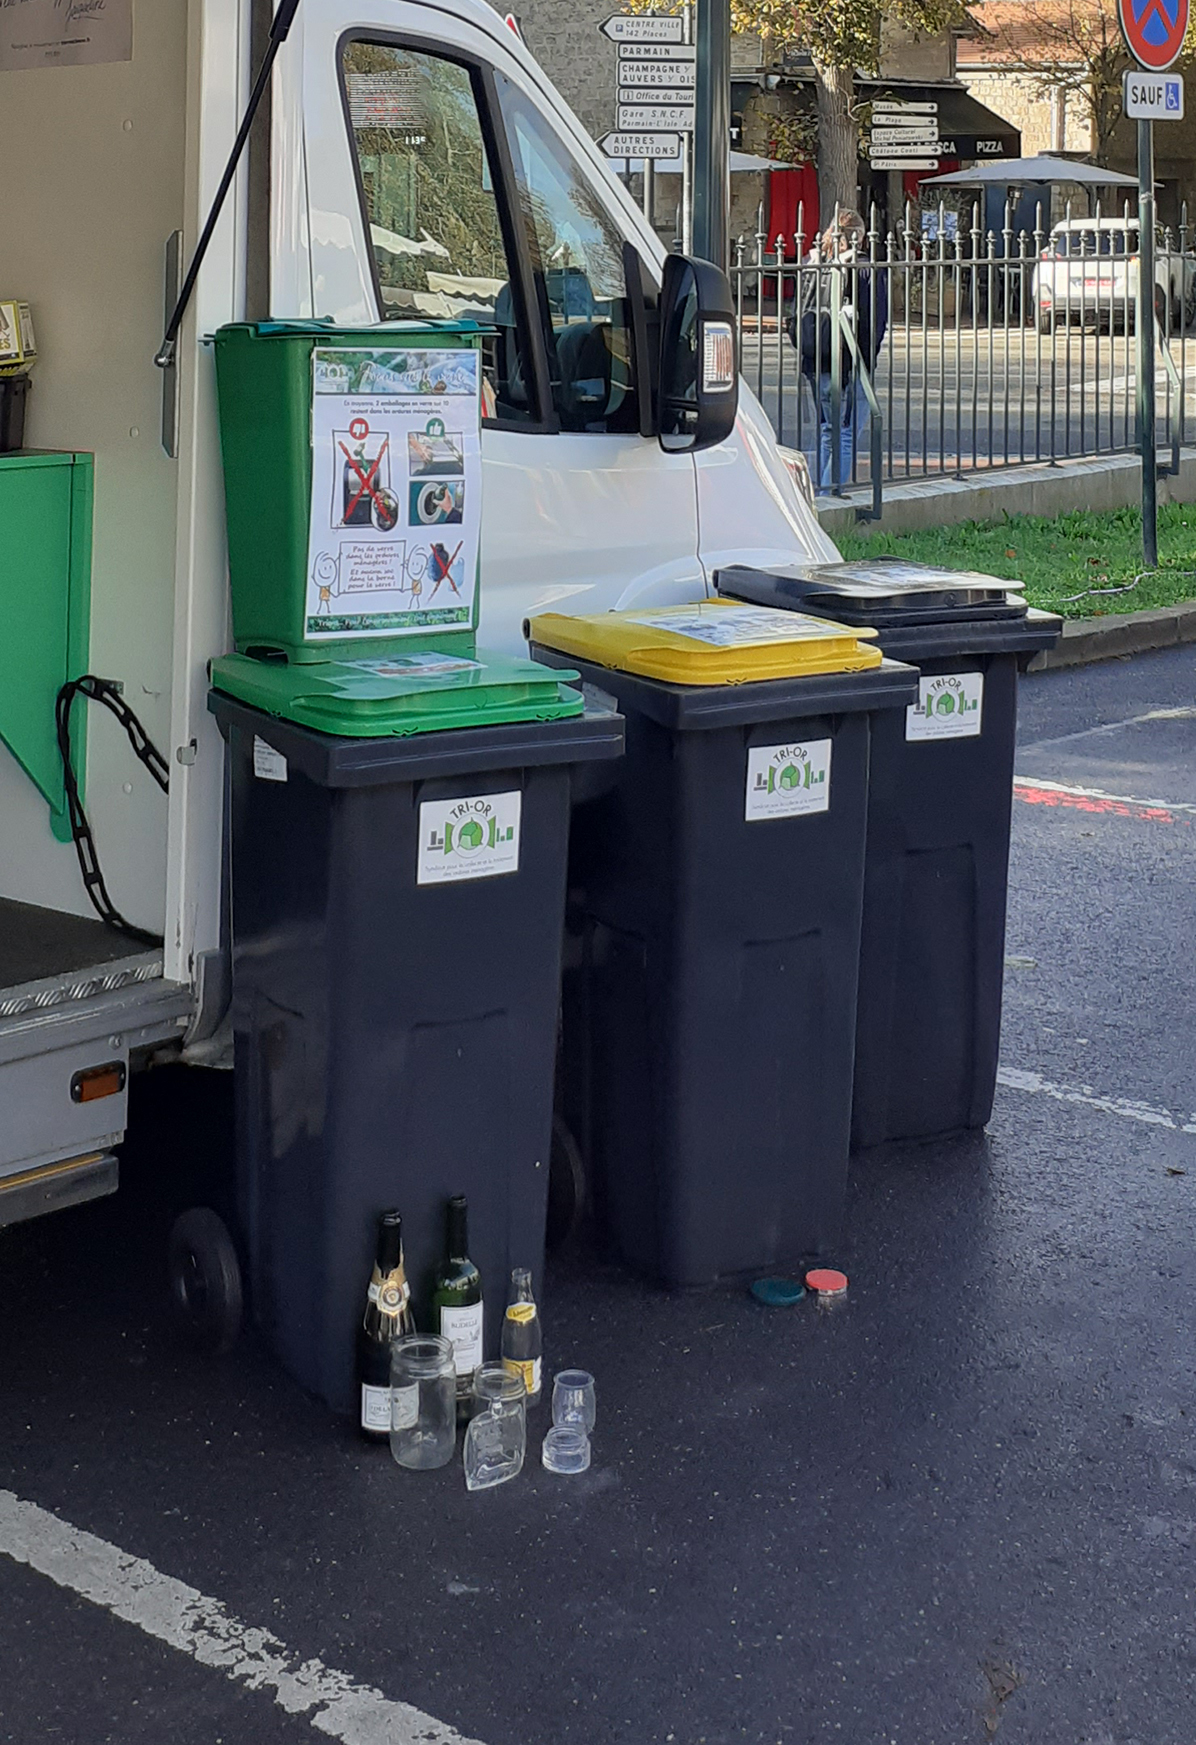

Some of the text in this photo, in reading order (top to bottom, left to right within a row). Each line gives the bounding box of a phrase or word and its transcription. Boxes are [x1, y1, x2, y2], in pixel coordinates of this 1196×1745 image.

[625, 20, 655, 28] CENTRE
[642, 30, 668, 38] Places
[622, 47, 671, 56] PARMAIN
[621, 64, 681, 74] CHAMPAGNE
[622, 74, 664, 83] AUVERS
[635, 91, 661, 101] Office
[662, 92, 673, 101] du
[1131, 85, 1163, 105] SAUF
[621, 109, 687, 119] Gare S.N.C.F.
[885, 116, 902, 124] Plage
[613, 136, 655, 145] AUTRES
[613, 146, 676, 155] DIRECTIONS
[976, 140, 1004, 153] PIZZA
[380, 399, 411, 407] emballages
[353, 545, 365, 553] Pas
[929, 677, 962, 691] TRI-OR
[773, 746, 808, 763] TRI-OR
[449, 800, 492, 819] TRI-OR
